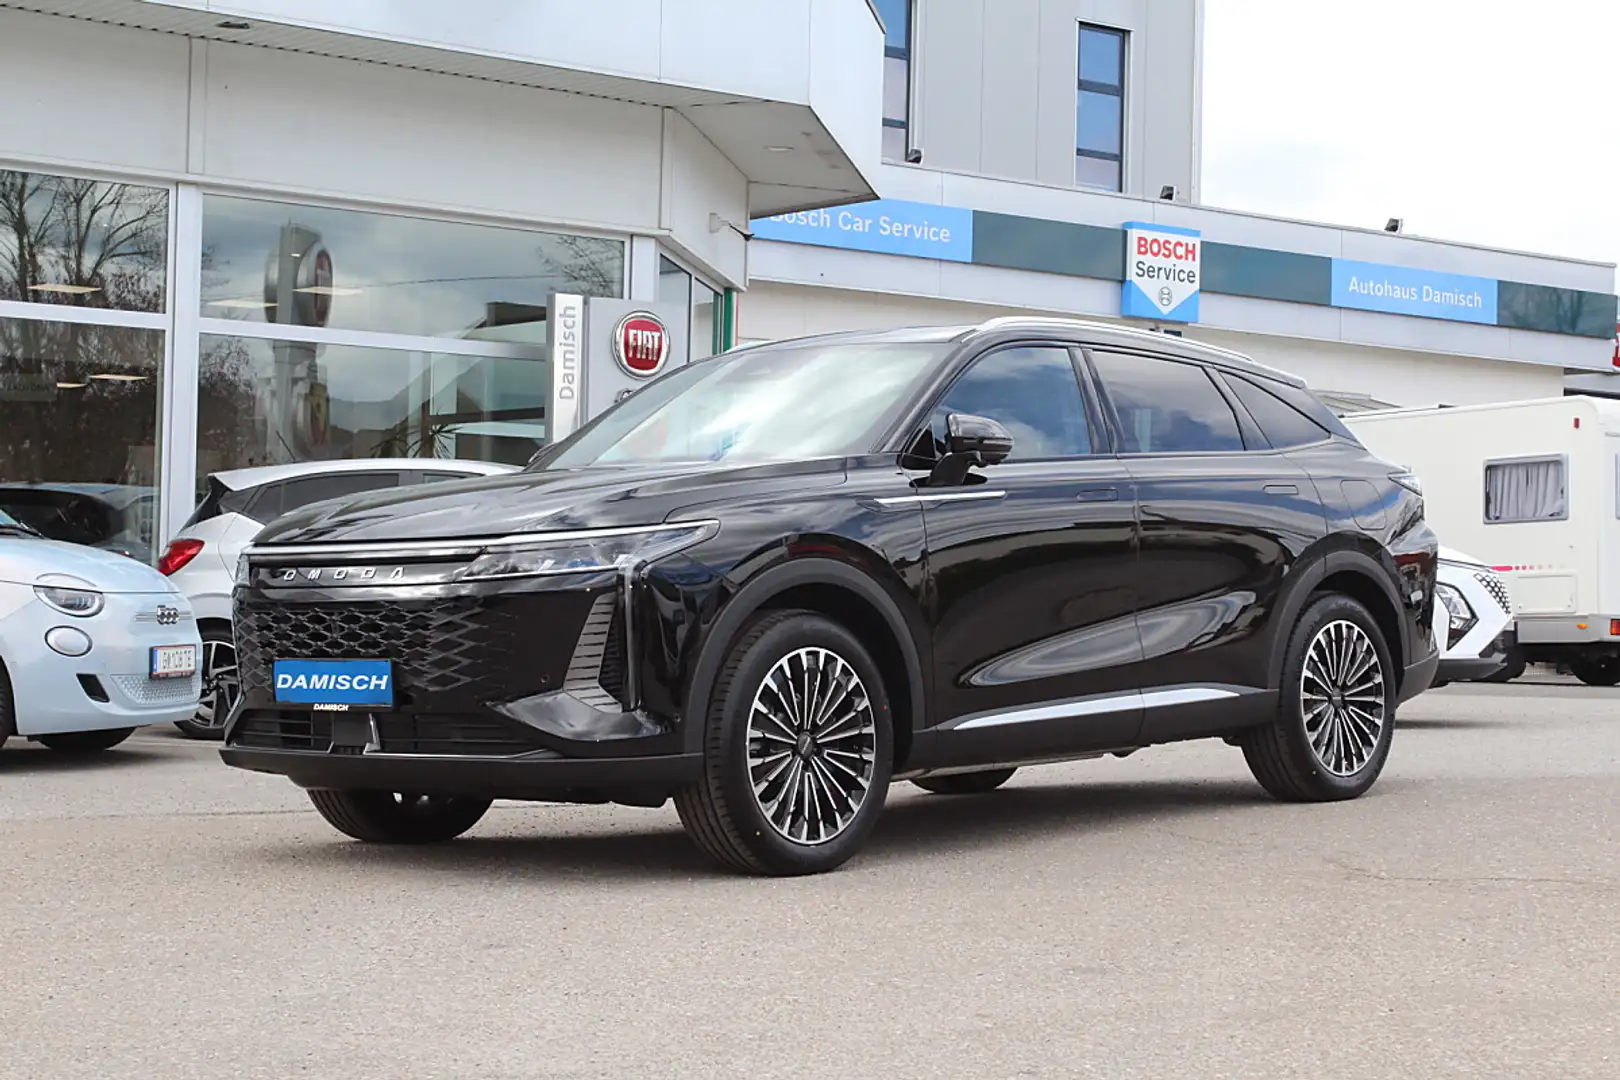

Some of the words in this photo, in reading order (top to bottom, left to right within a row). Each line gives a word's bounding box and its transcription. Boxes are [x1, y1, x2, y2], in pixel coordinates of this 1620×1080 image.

[838, 211, 873, 233] Car
[879, 216, 952, 243] Service
[1136, 236, 1196, 262] BOSCH
[1135, 260, 1197, 284] Service
[1349, 276, 1418, 301] Autohaus
[1422, 285, 1483, 309] Damisch
[559, 305, 577, 400] Damisch
[628, 329, 661, 361] FIAT
[283, 566, 405, 581] OMODA
[276, 674, 389, 690] DAMISCH
[313, 703, 350, 711] DAMISCH
